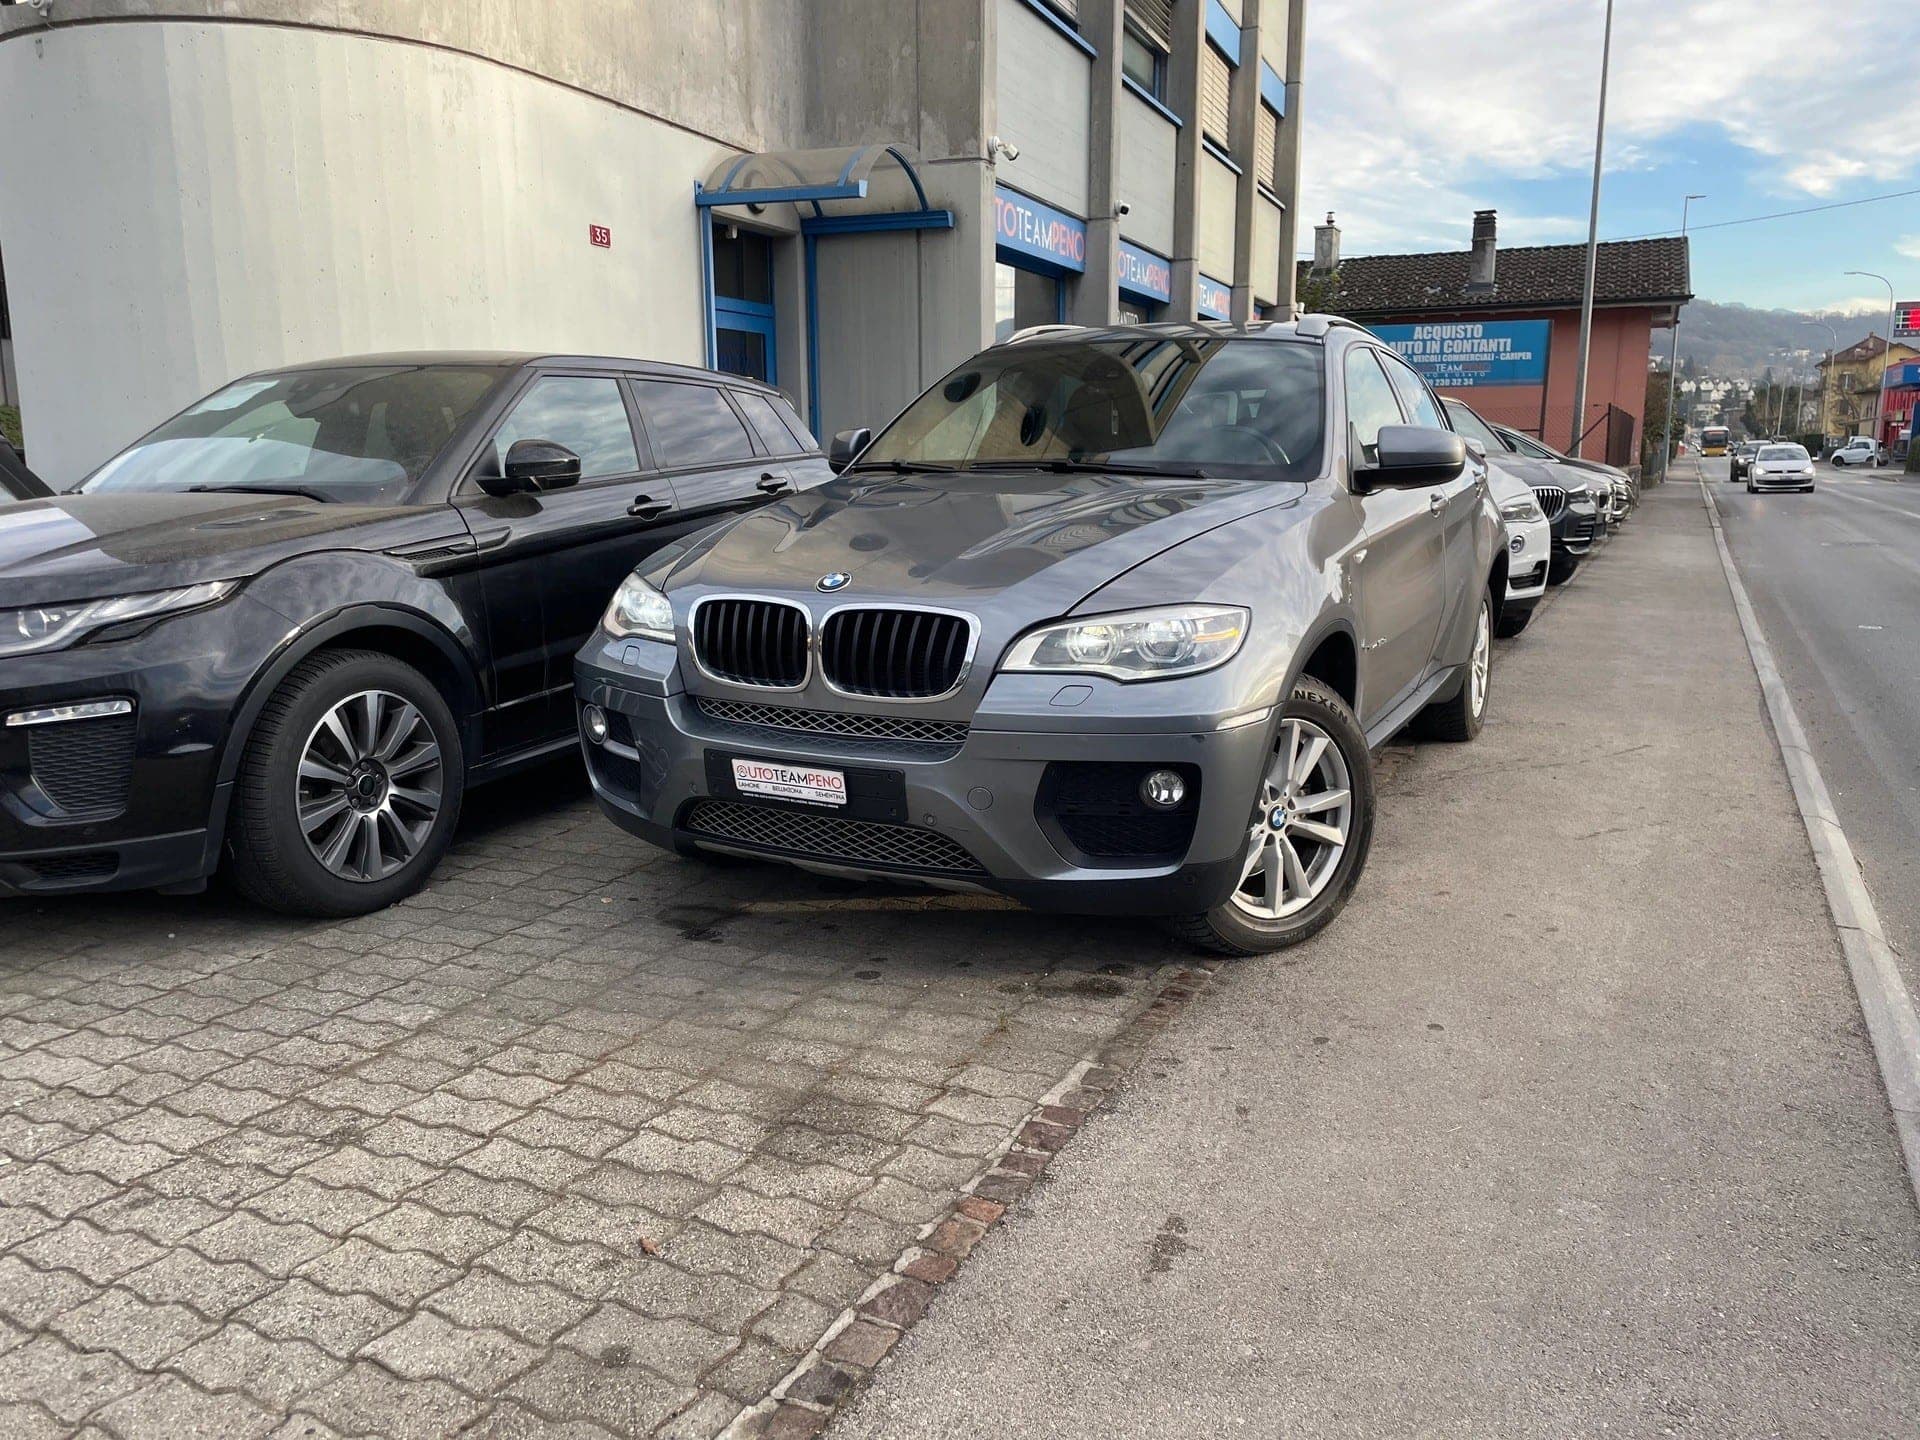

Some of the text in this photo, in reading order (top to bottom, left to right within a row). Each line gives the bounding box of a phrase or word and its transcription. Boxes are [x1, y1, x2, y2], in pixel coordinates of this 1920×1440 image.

[1413, 325, 1482, 341] ACQUISTO
[1426, 340, 1440, 354] IN
[1443, 338, 1512, 354] CONTANTI
[1442, 353, 1495, 362] COMMERCIALI
[1500, 352, 1532, 361] CAMPER
[1294, 690, 1348, 725] NEXEN
